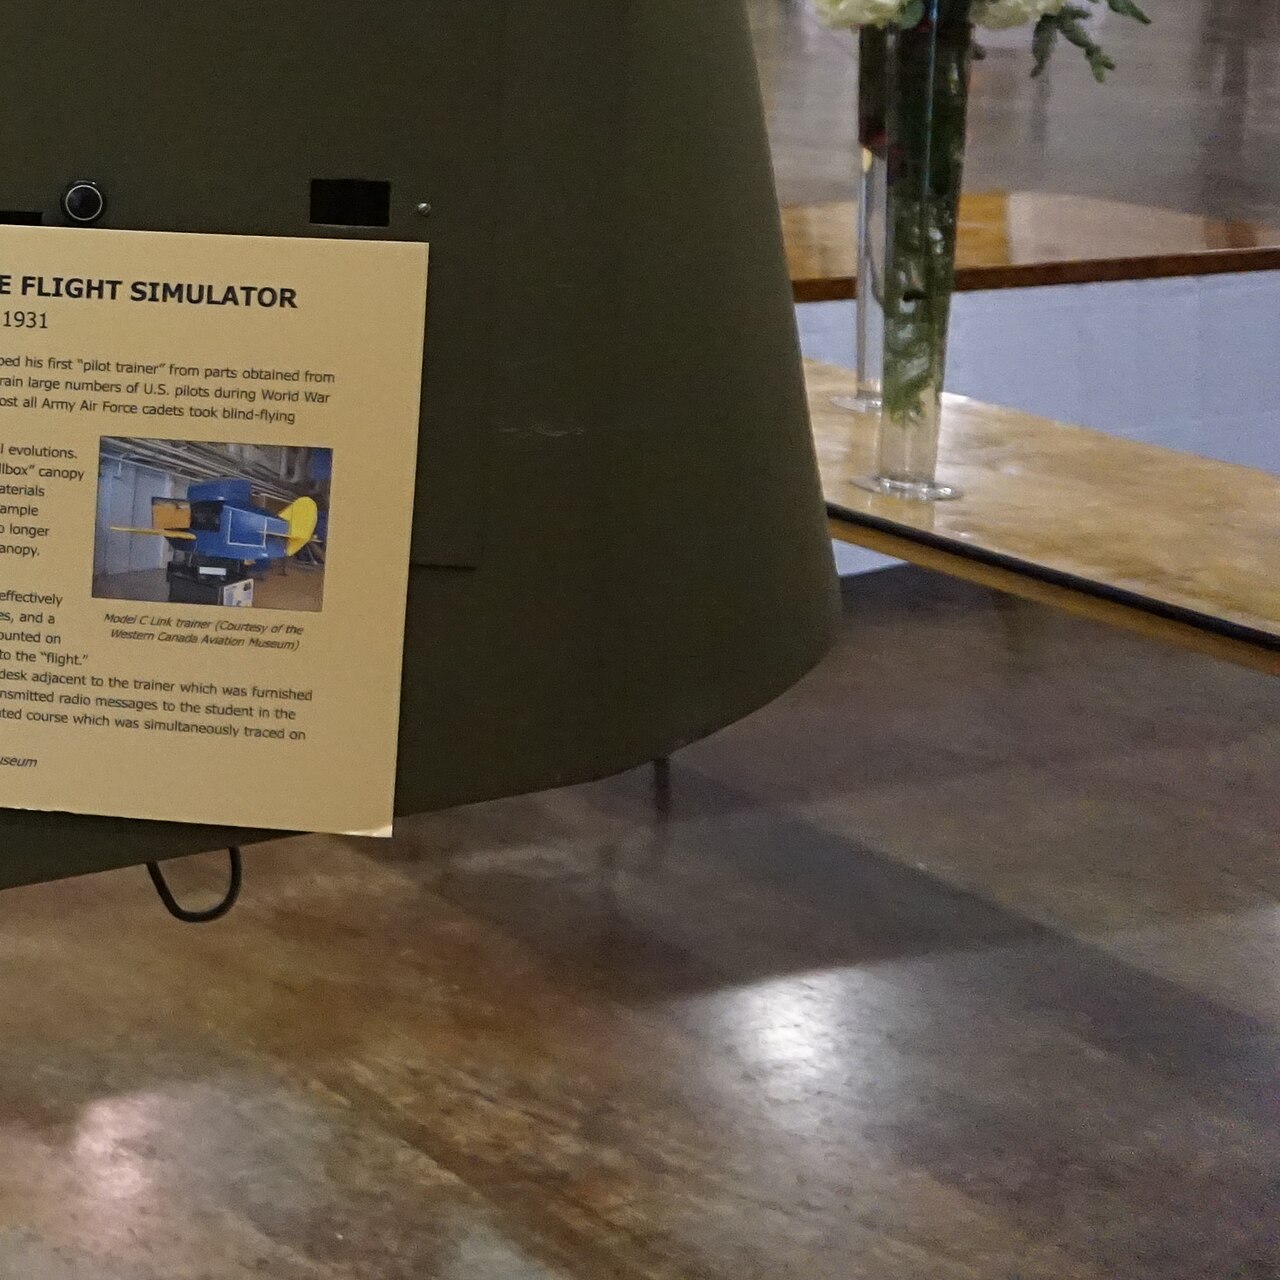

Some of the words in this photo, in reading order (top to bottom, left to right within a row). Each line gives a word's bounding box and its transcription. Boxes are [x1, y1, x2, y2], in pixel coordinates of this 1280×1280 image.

[21, 275, 123, 300] FLIGHT
[129, 281, 298, 309] SIMULATOR
[3, 310, 48, 329] 1931
[24, 355, 43, 369] his
[47, 357, 73, 370] first
[169, 363, 200, 376] from
[204, 367, 238, 380] parts
[242, 367, 300, 382] obtained
[304, 370, 335, 383] from
[28, 376, 61, 392] large
[65, 379, 122, 393] numbers
[126, 382, 140, 394] of
[144, 383, 169, 396] U.S.
[175, 385, 210, 398] pilots
[214, 386, 256, 403] during
[261, 388, 299, 402] World
[304, 391, 331, 403] War
[23, 396, 37, 408] all
[41, 398, 76, 413] Army
[79, 400, 98, 412] Air
[102, 401, 138, 414] Force
[142, 404, 185, 417] cadets
[189, 406, 218, 418] took
[222, 407, 295, 425] blind-flying
[103, 613, 137, 624] Model
[139, 615, 149, 625] C
[150, 617, 173, 627] Link
[176, 619, 213, 629] trainer
[215, 620, 268, 635] (Courtesy
[270, 624, 285, 633] of
[285, 625, 304, 636] the
[45, 634, 61, 644] on
[111, 629, 155, 640] Western
[157, 632, 198, 644] Canada
[200, 634, 245, 646] Aviation
[248, 637, 300, 652] Museum)
